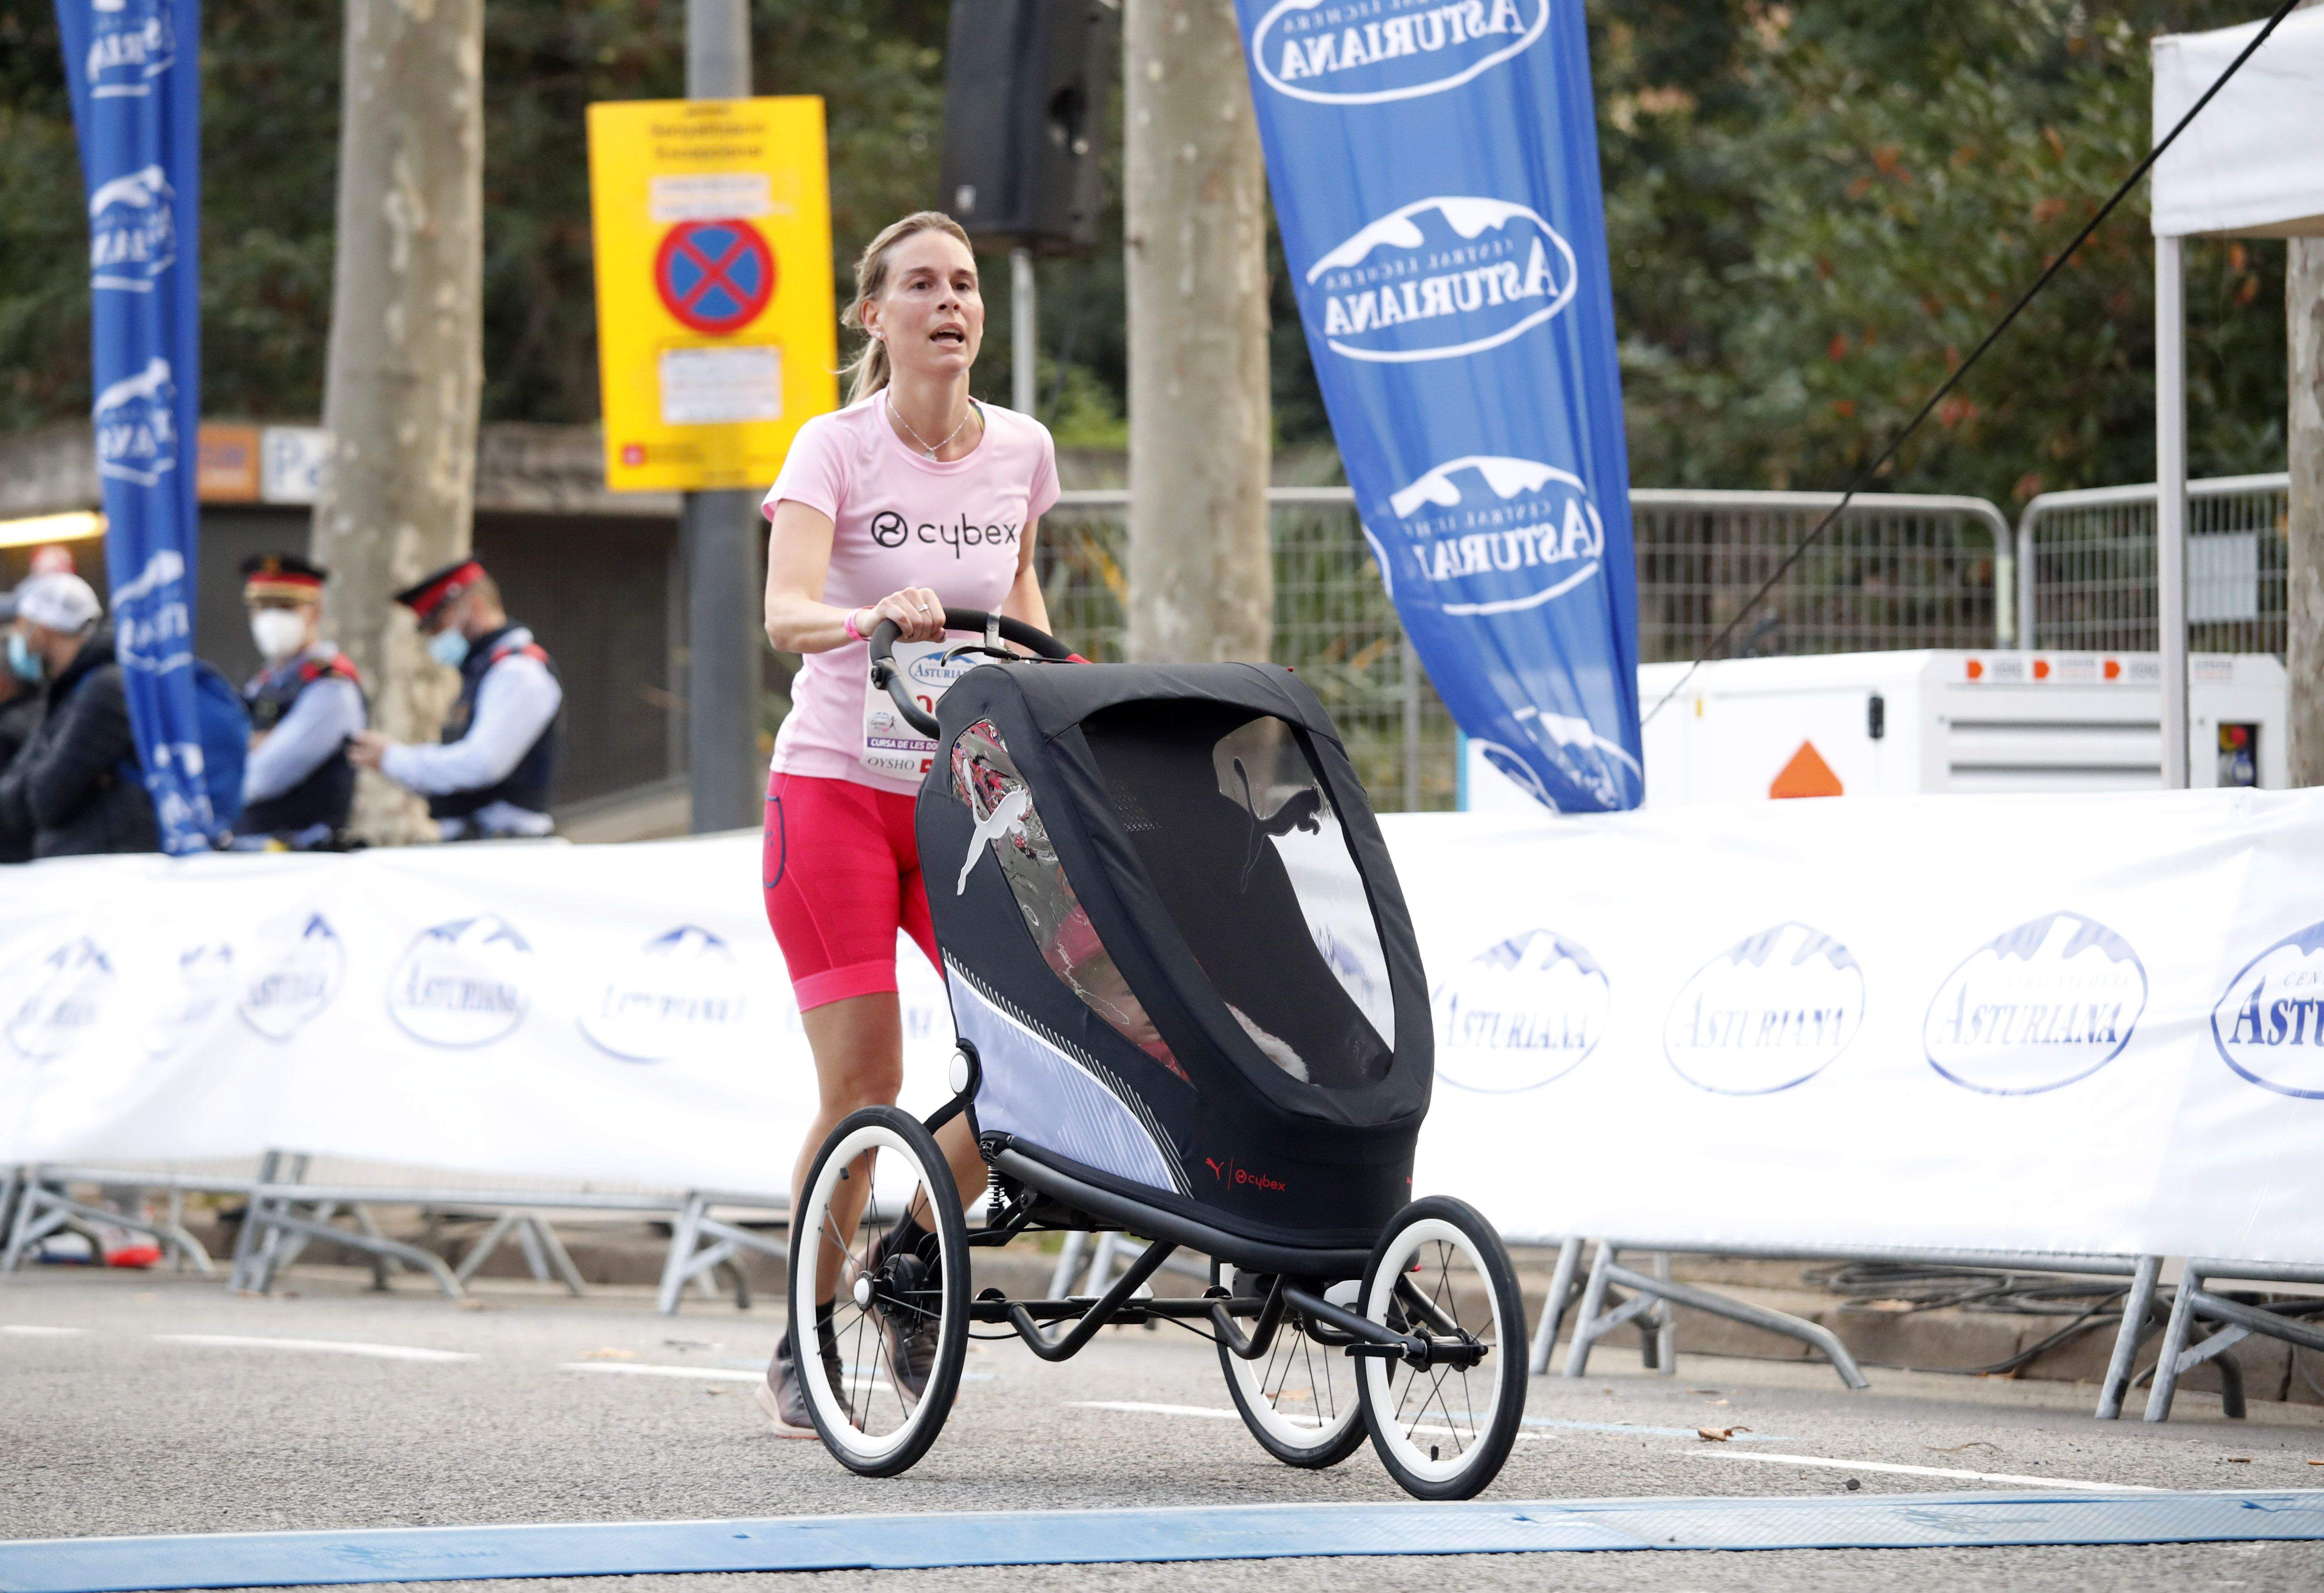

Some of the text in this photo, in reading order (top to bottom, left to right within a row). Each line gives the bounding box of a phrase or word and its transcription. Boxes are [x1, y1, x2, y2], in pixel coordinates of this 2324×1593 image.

[917, 512, 1017, 559] cybex
[914, 663, 966, 678] ASTURIA
[871, 739, 896, 748] CURSA
[897, 740, 909, 748] DE
[909, 741, 925, 749] LES
[868, 757, 914, 770] OYSHO
[1935, 980, 2123, 1045] ASTURIANA
[1248, 1174, 1285, 1191] cybex
